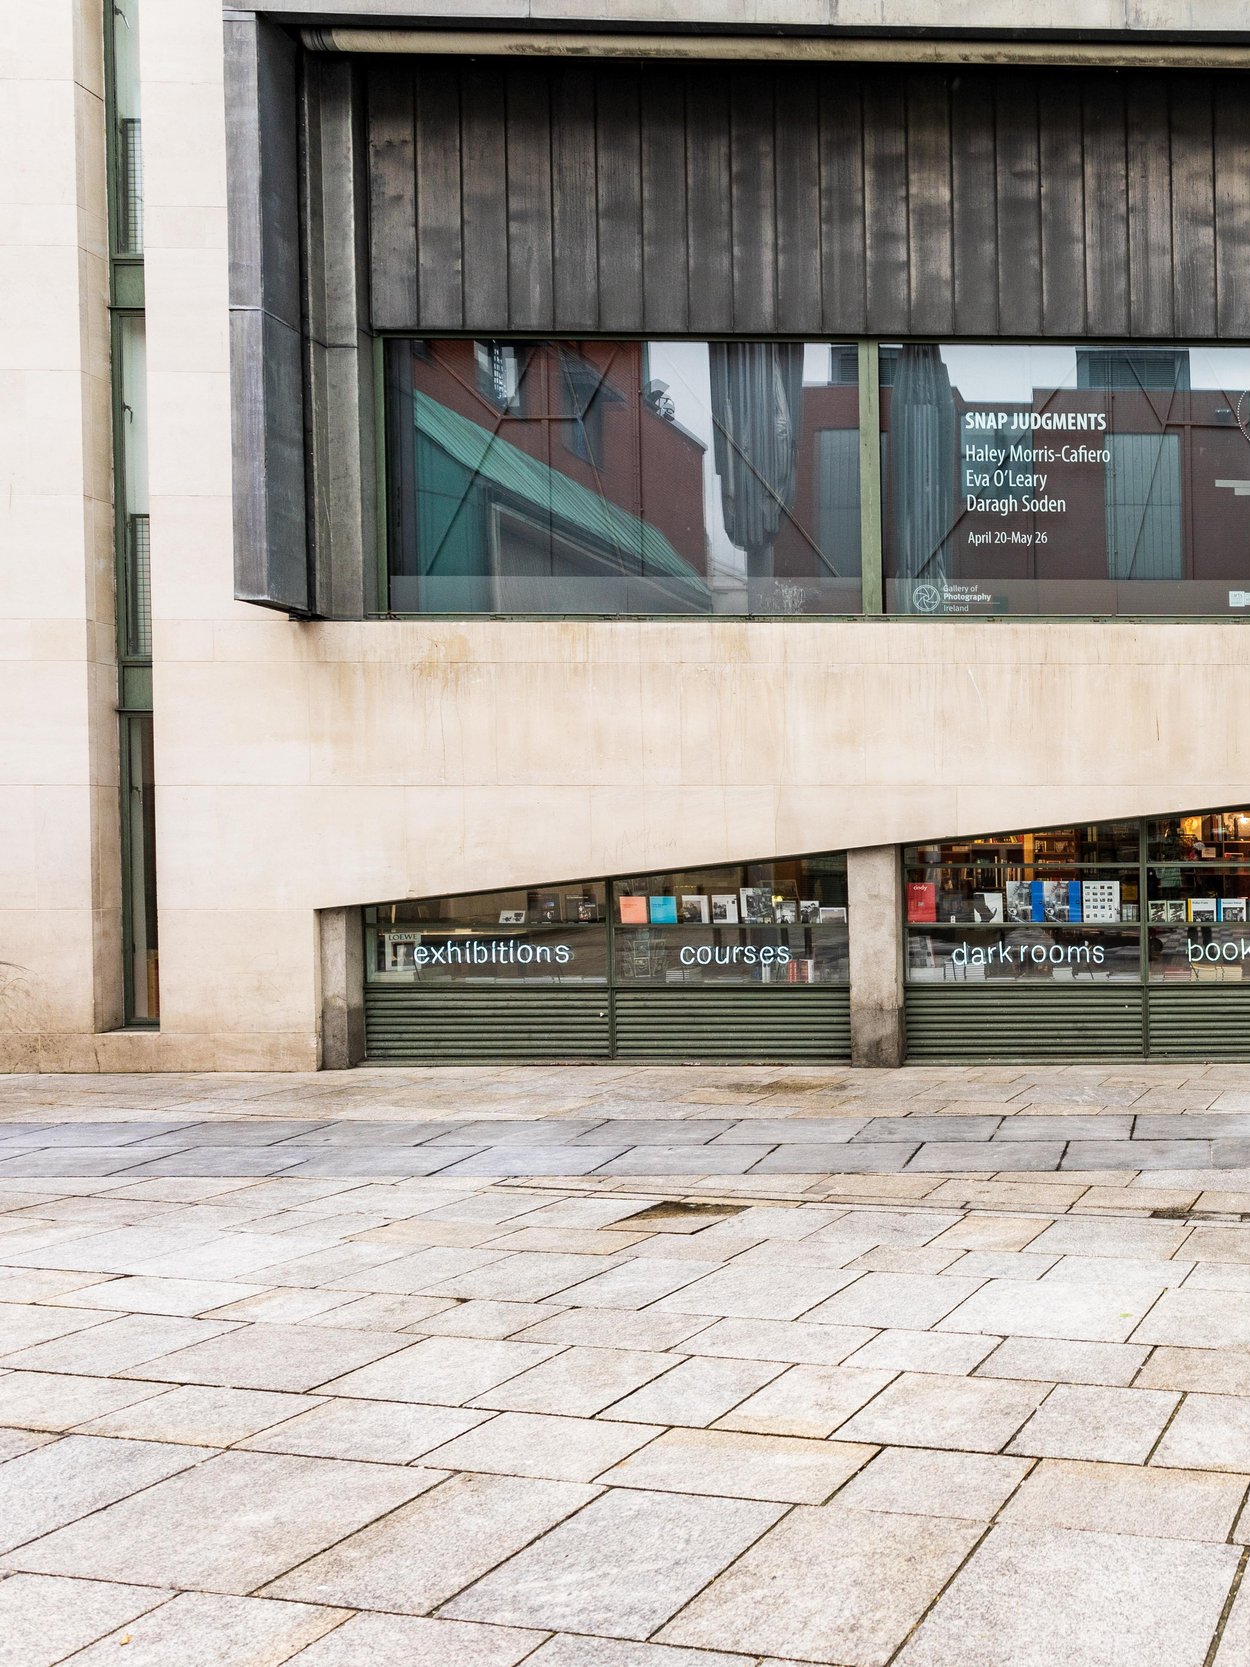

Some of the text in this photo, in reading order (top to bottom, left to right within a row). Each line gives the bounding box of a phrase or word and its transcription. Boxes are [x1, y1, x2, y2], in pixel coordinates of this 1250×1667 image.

[965, 412, 1106, 430] SNAP JUDGMENTS
[965, 444, 1111, 466] Haley Morris-Cafiero
[966, 470, 990, 487] Eva
[967, 494, 1066, 516] Daragh Soden
[968, 531, 1047, 547] April 20-May 26
[943, 585, 969, 593] Gallery
[943, 593, 991, 601] Photography
[413, 939, 570, 964] exhibitions
[679, 945, 790, 965] courses
